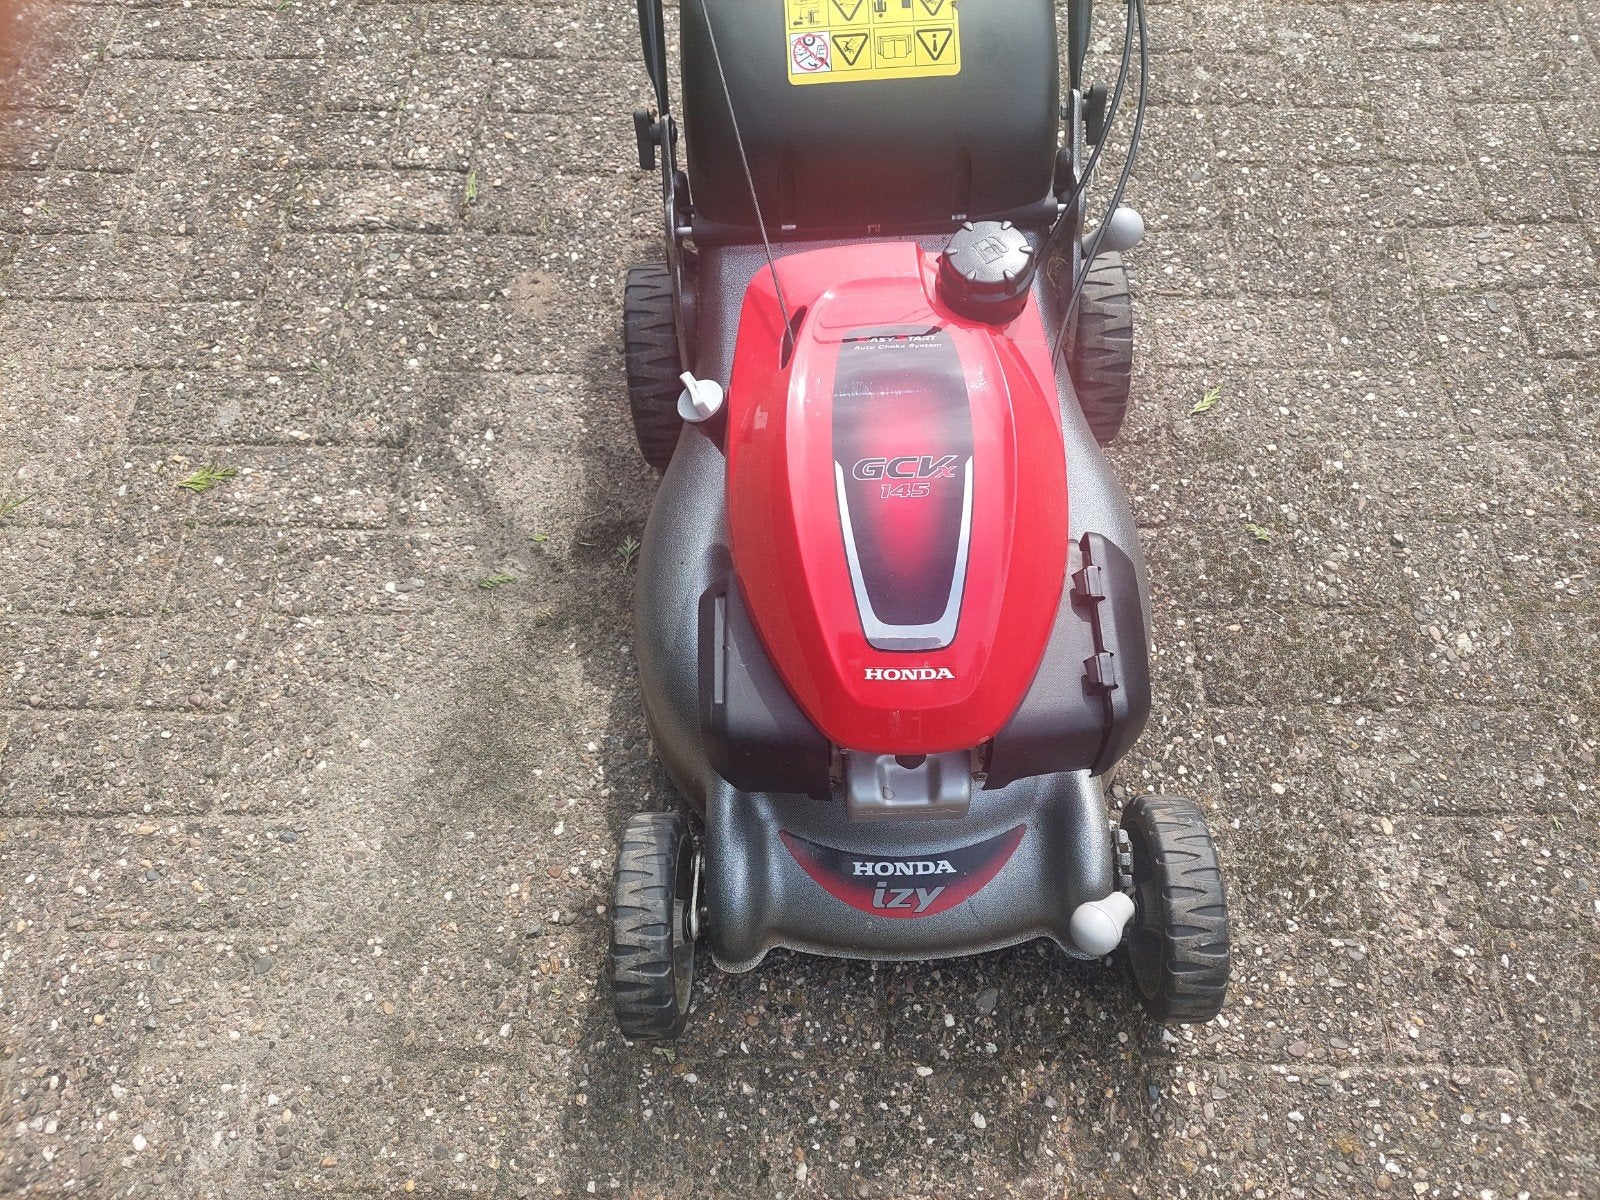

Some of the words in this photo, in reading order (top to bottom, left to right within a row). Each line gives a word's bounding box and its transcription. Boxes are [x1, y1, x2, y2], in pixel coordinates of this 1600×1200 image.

[880, 482, 931, 499] 145
[864, 667, 955, 680] HONDA
[852, 860, 957, 876] HONDA
[872, 880, 946, 914] izy
